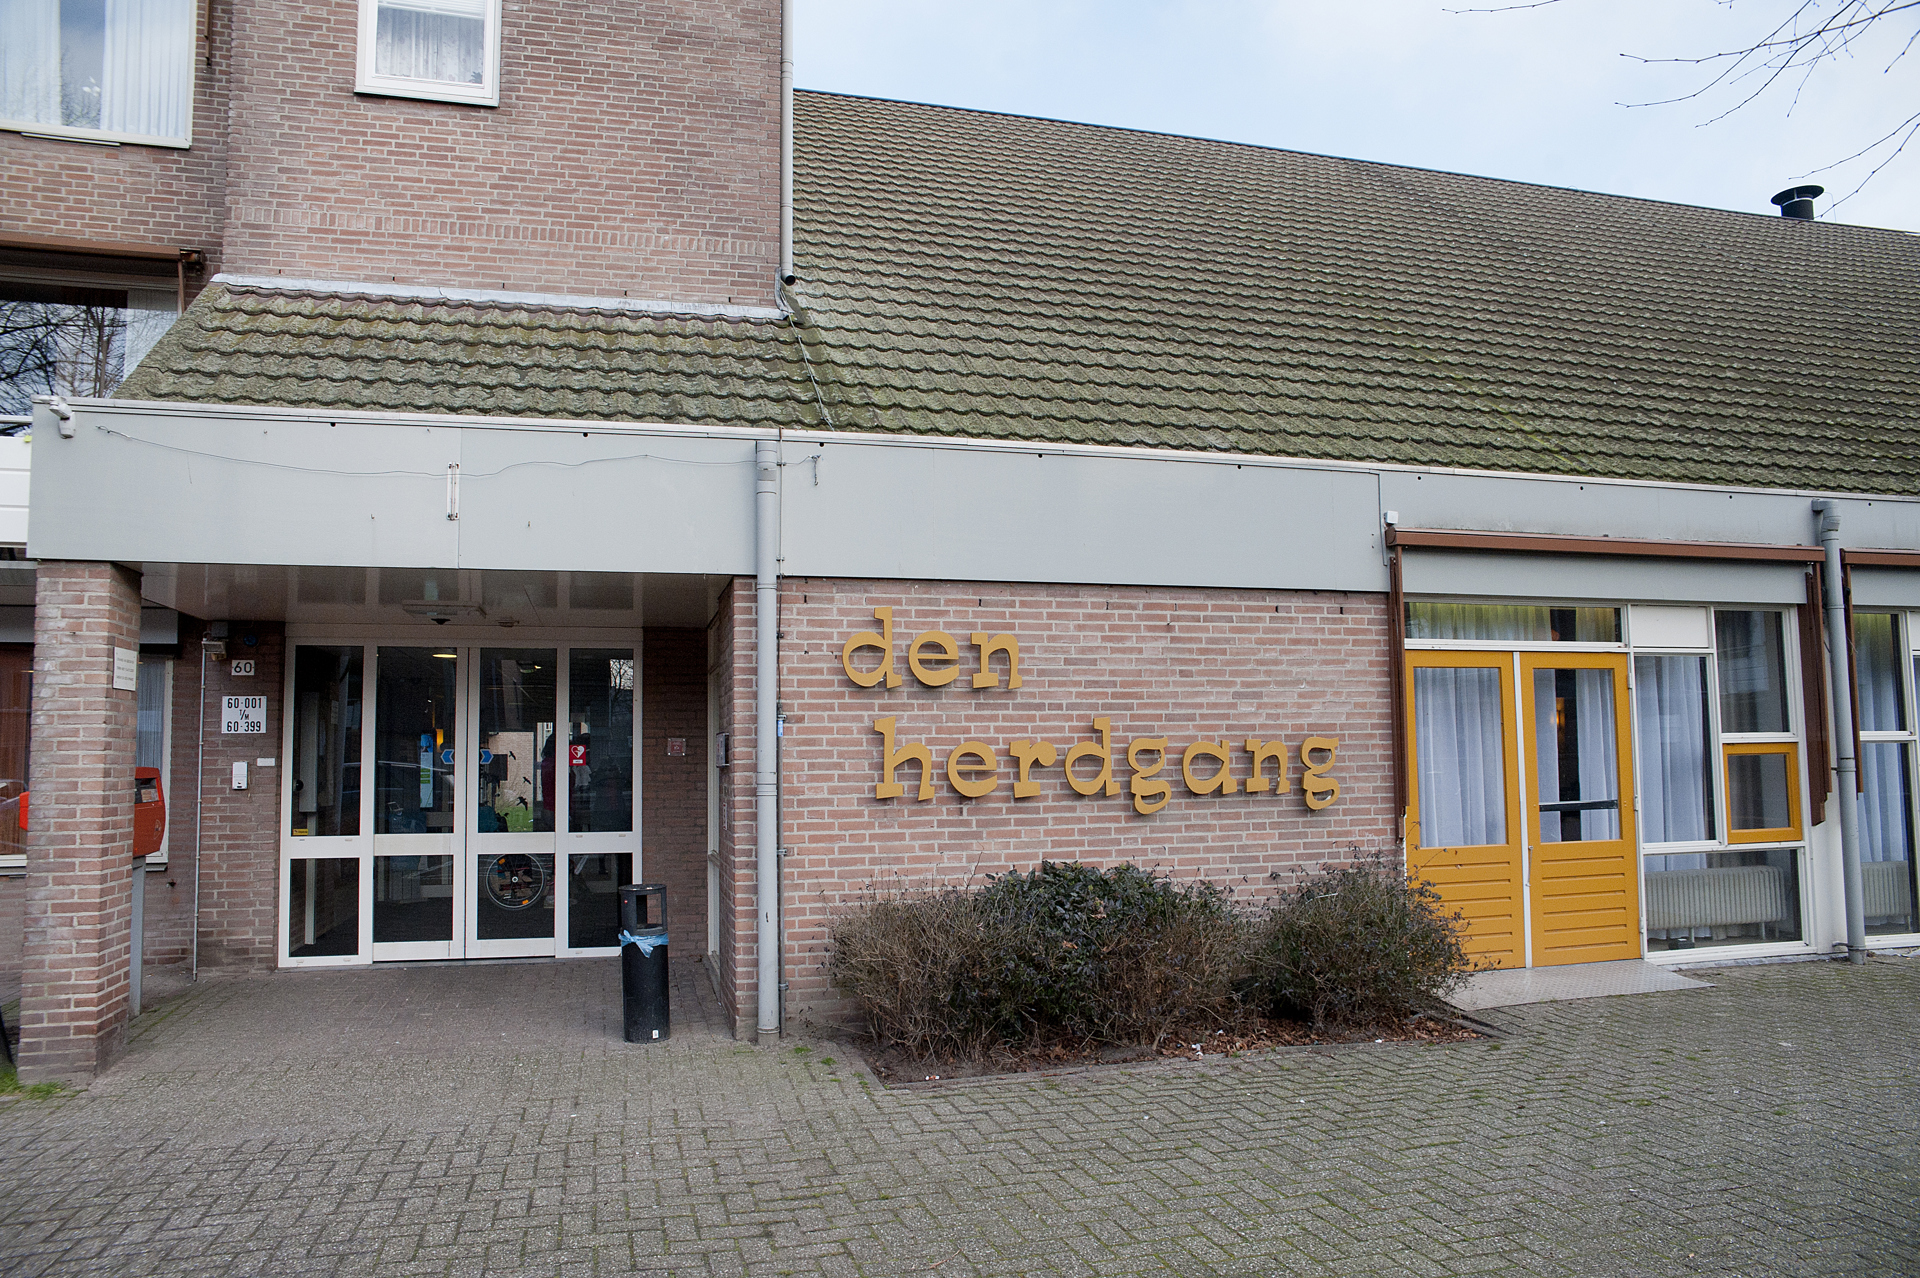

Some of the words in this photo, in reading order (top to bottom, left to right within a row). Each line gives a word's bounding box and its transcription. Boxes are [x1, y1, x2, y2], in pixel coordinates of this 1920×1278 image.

[234, 662, 252, 673] 60
[842, 606, 1023, 689] den
[873, 715, 1341, 816] herdgang
